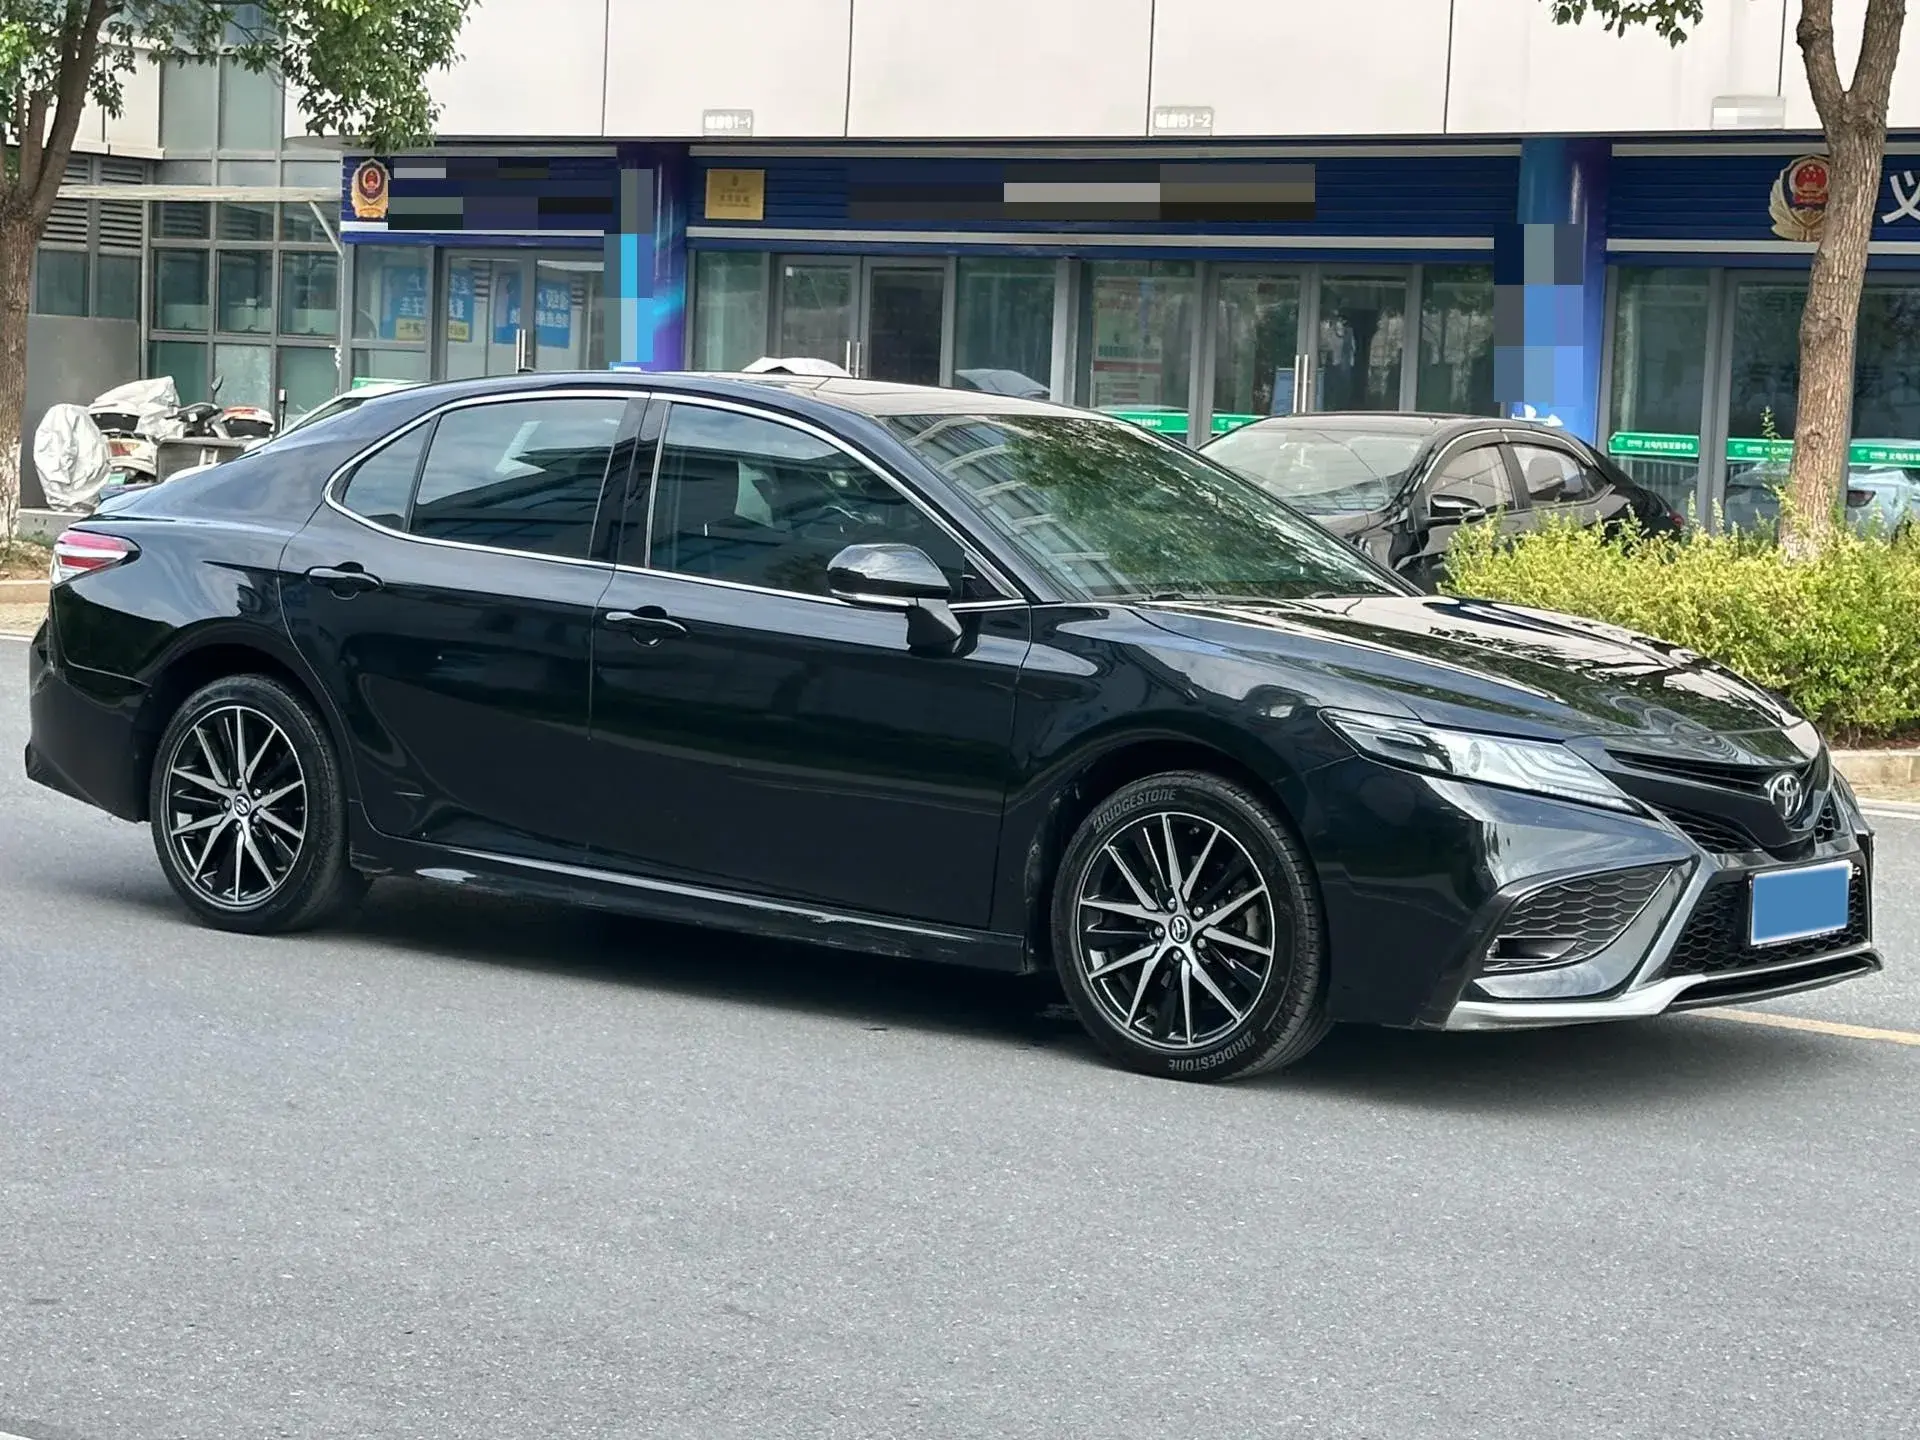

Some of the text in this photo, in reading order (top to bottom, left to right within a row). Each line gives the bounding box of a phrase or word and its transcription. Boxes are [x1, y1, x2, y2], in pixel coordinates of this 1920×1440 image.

[1881, 170, 1920, 224] 义
[1093, 788, 1177, 834] BRIDGESTONE
[1168, 1030, 1257, 1072] BRIDGESTONE
